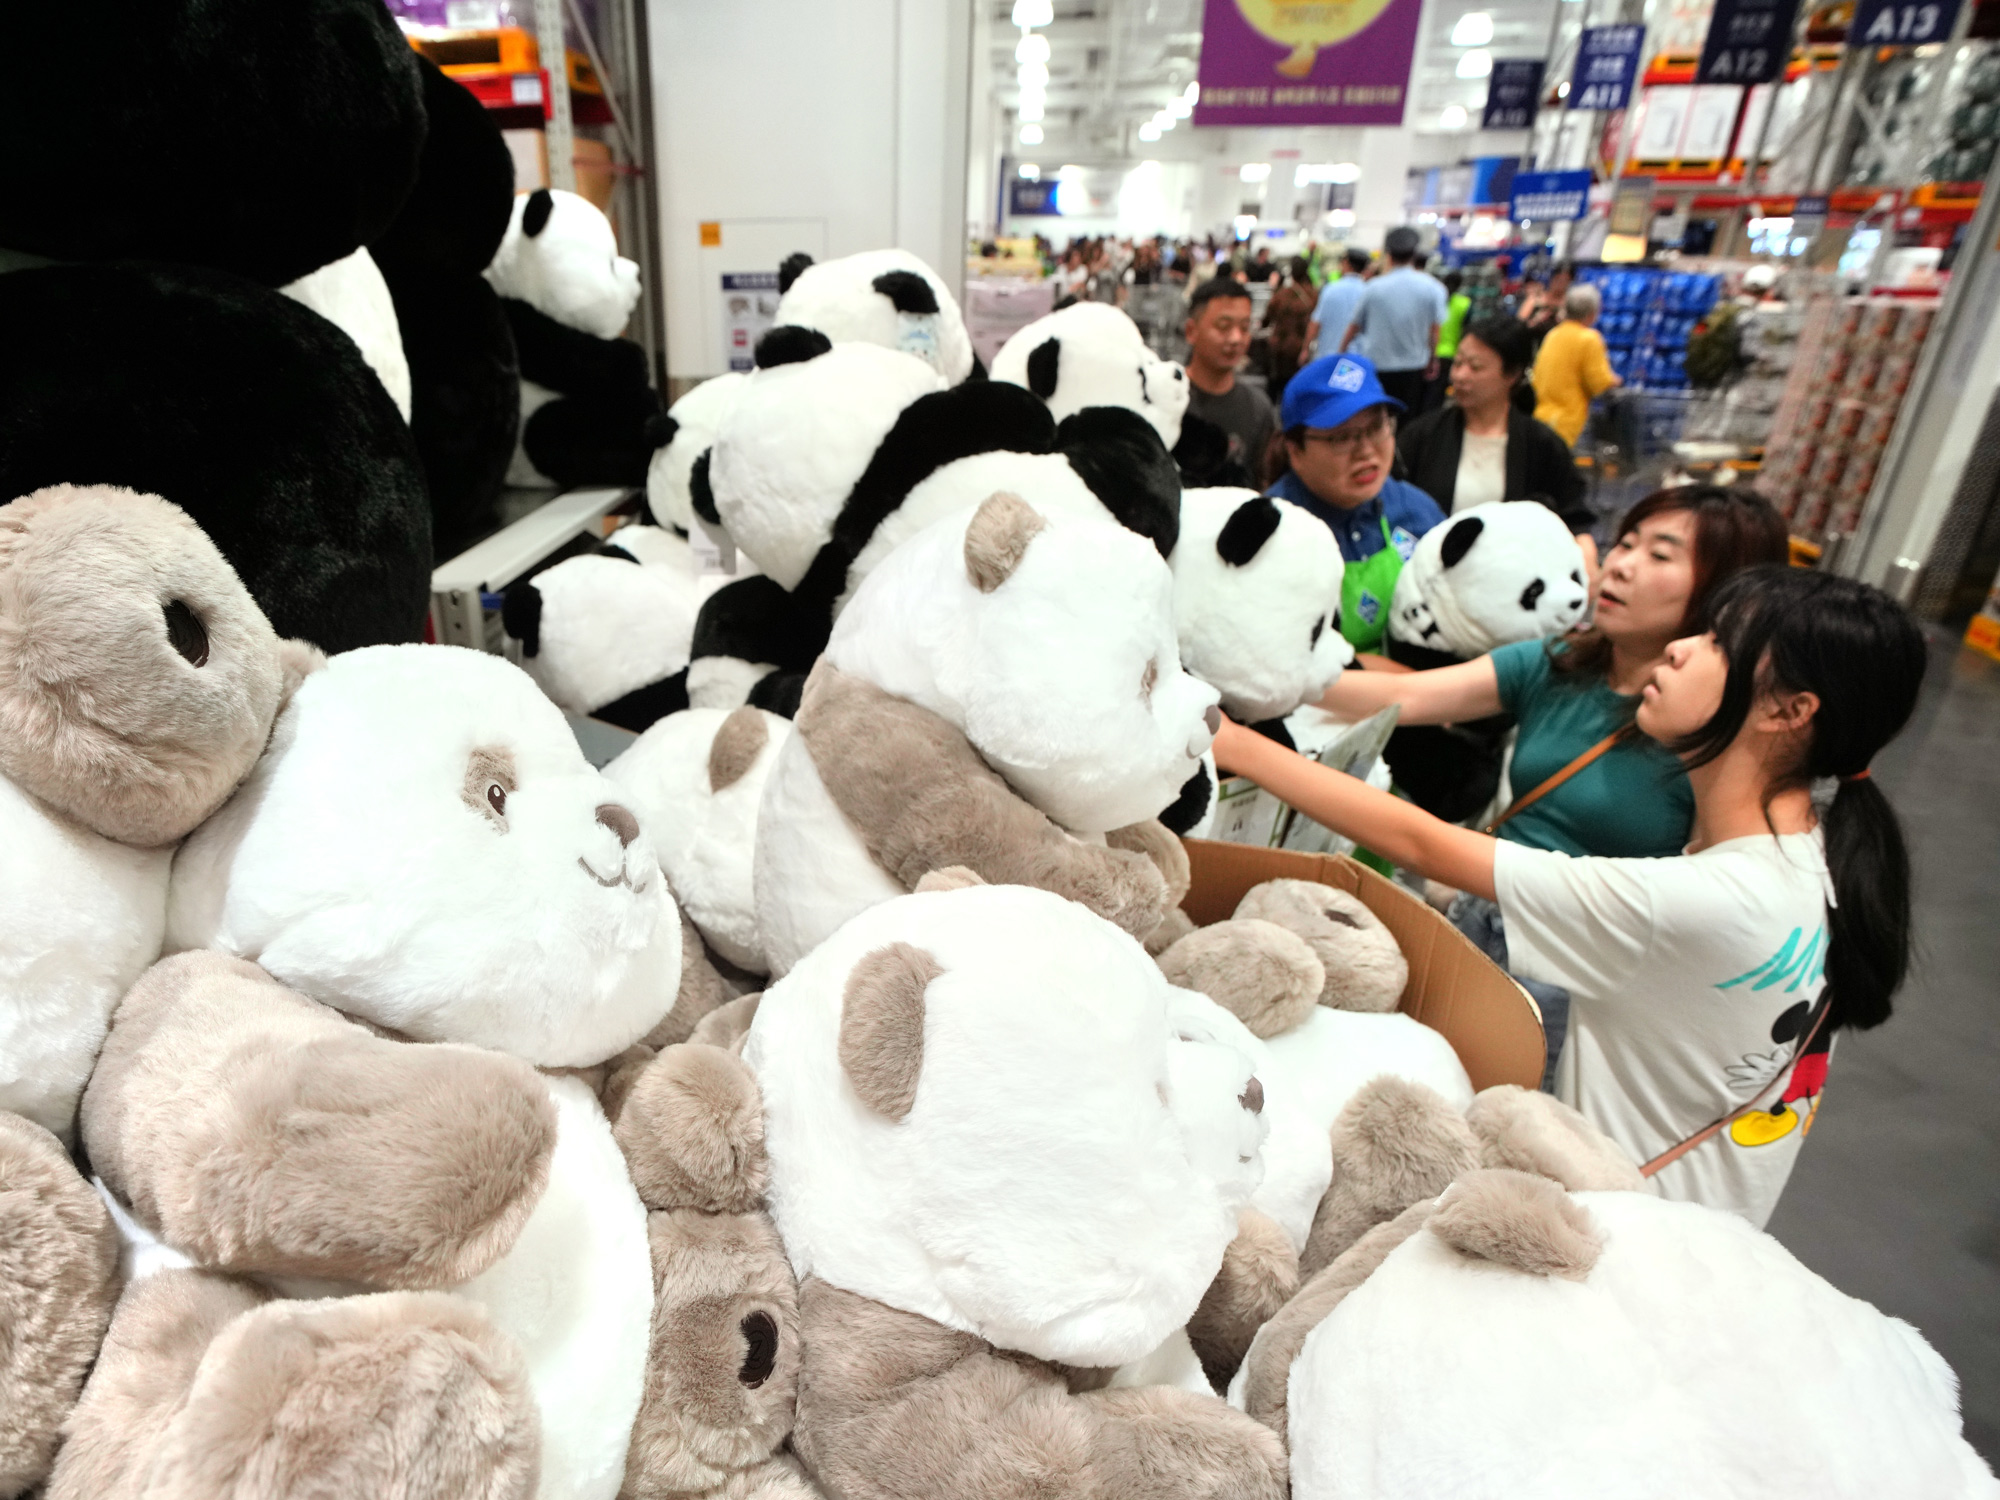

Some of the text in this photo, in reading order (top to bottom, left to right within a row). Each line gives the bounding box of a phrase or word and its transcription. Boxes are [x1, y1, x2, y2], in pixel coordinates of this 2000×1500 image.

[1865, 4, 1940, 40] A13
[1709, 49, 1769, 78] A12
[1578, 83, 1623, 108] A11
